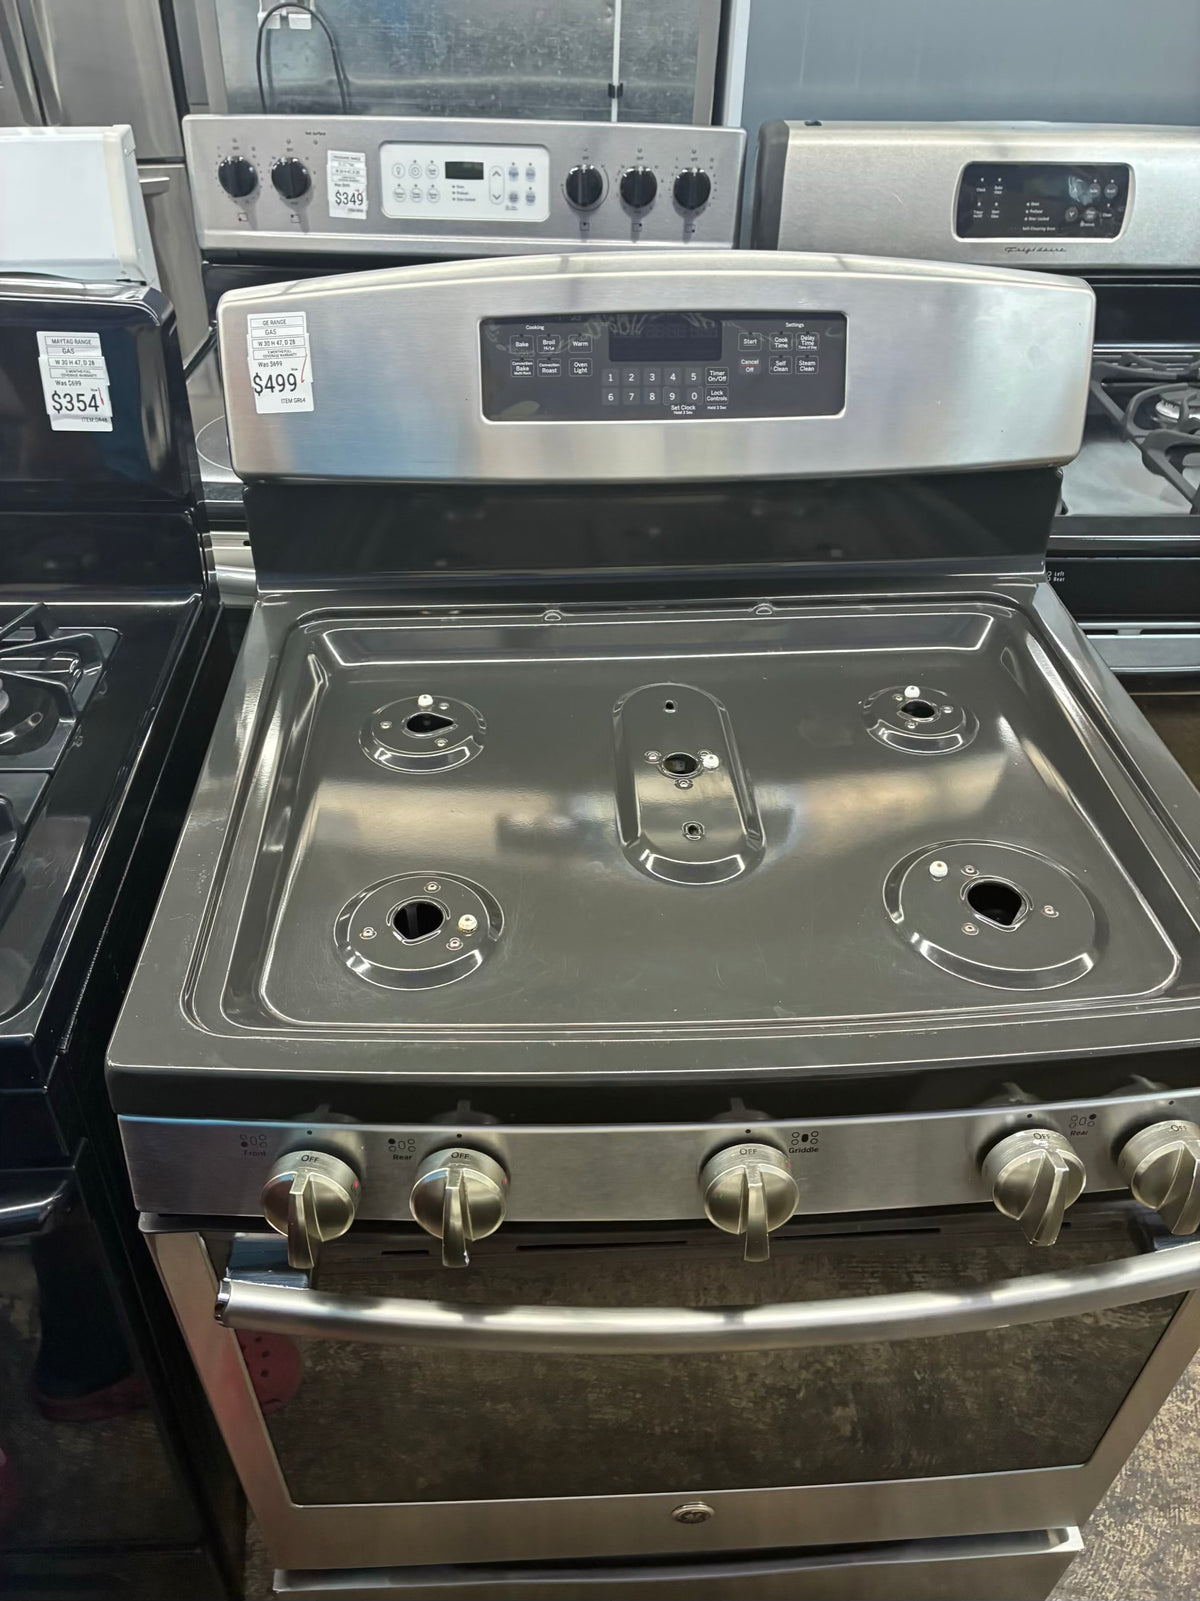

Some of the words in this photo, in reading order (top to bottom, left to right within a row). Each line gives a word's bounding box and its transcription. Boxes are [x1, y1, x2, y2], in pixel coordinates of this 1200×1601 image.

[335, 190, 363, 206] $349
[608, 373, 613, 382] 1
[628, 373, 635, 381] 2
[649, 373, 655, 381] 3
[669, 373, 676, 381] 4
[691, 372, 697, 381] 5
[253, 372, 297, 396] $499
[607, 393, 614, 401] 6
[628, 393, 635, 401] 7
[649, 392, 656, 401] 8
[669, 392, 676, 401] 9
[691, 392, 698, 400] 0
[51, 390, 99, 414] $354
[1171, 1124, 1187, 1132] OFF
[1033, 1132, 1050, 1140] OFF
[301, 1154, 319, 1163] OFF
[451, 1151, 470, 1159] OFF
